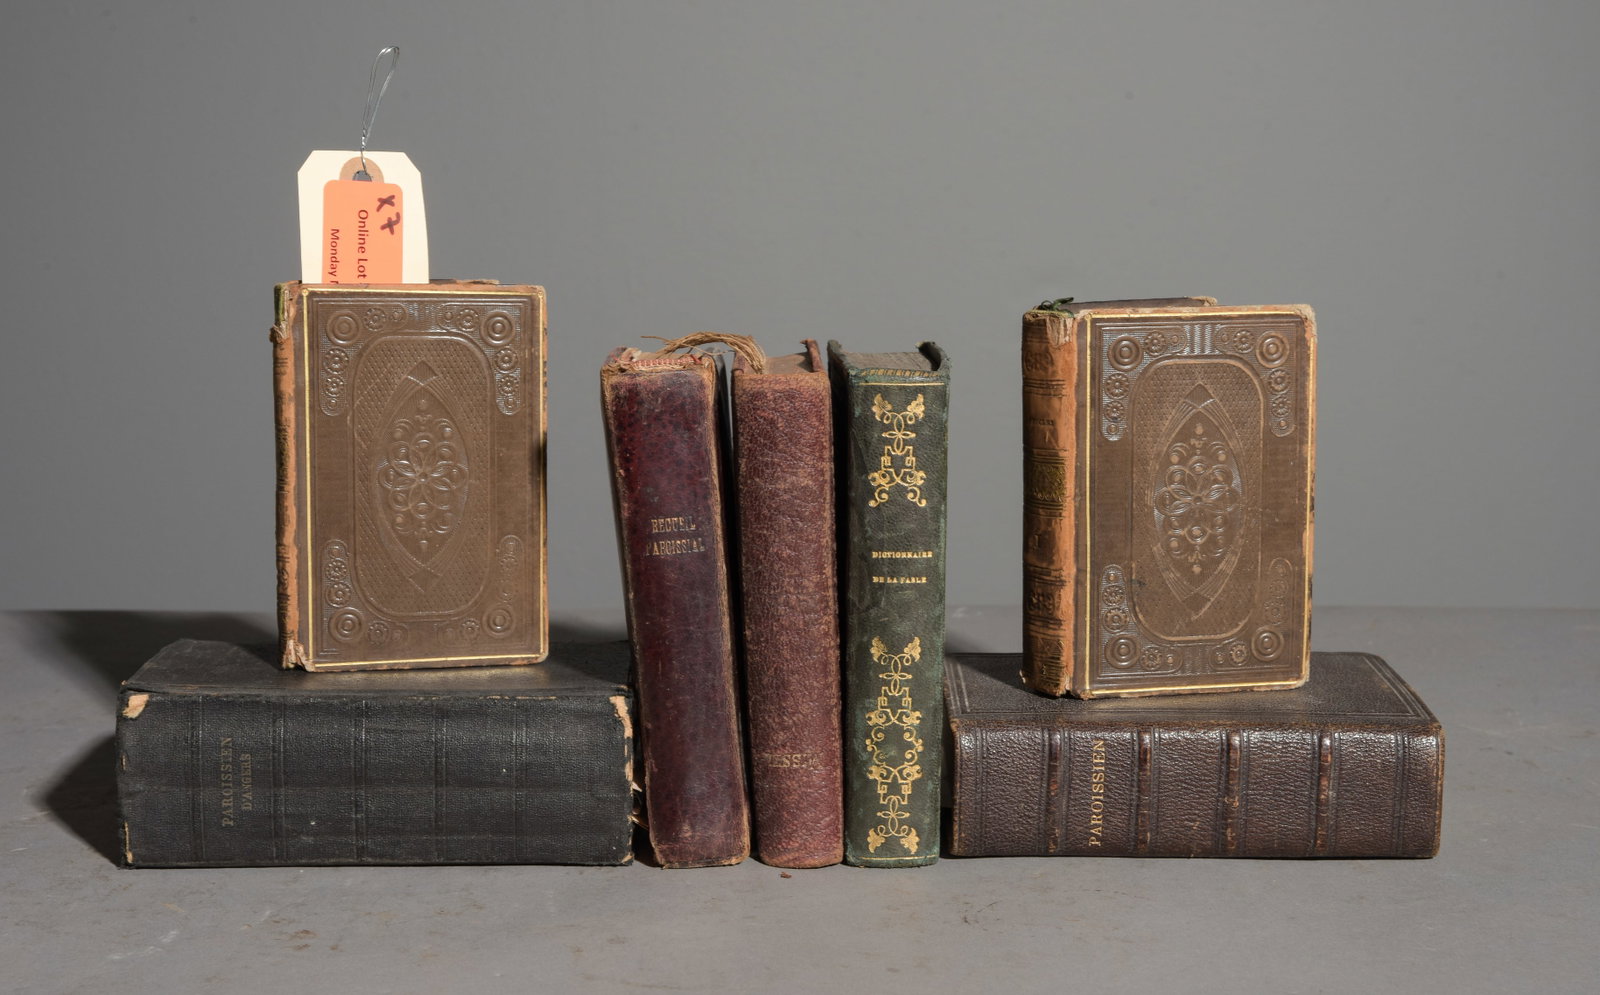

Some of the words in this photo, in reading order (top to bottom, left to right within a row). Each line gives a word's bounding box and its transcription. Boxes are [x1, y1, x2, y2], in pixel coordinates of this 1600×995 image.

[327, 228, 340, 277] Monday
[357, 209, 369, 254] Online
[357, 258, 369, 279] Lot
[872, 551, 933, 559] DICTIONNAIRE
[887, 576, 898, 584] LA
[900, 576, 927, 584] FABLE
[220, 737, 234, 828] PAROISSIEN
[1088, 739, 1106, 847] PAROISSIEN
